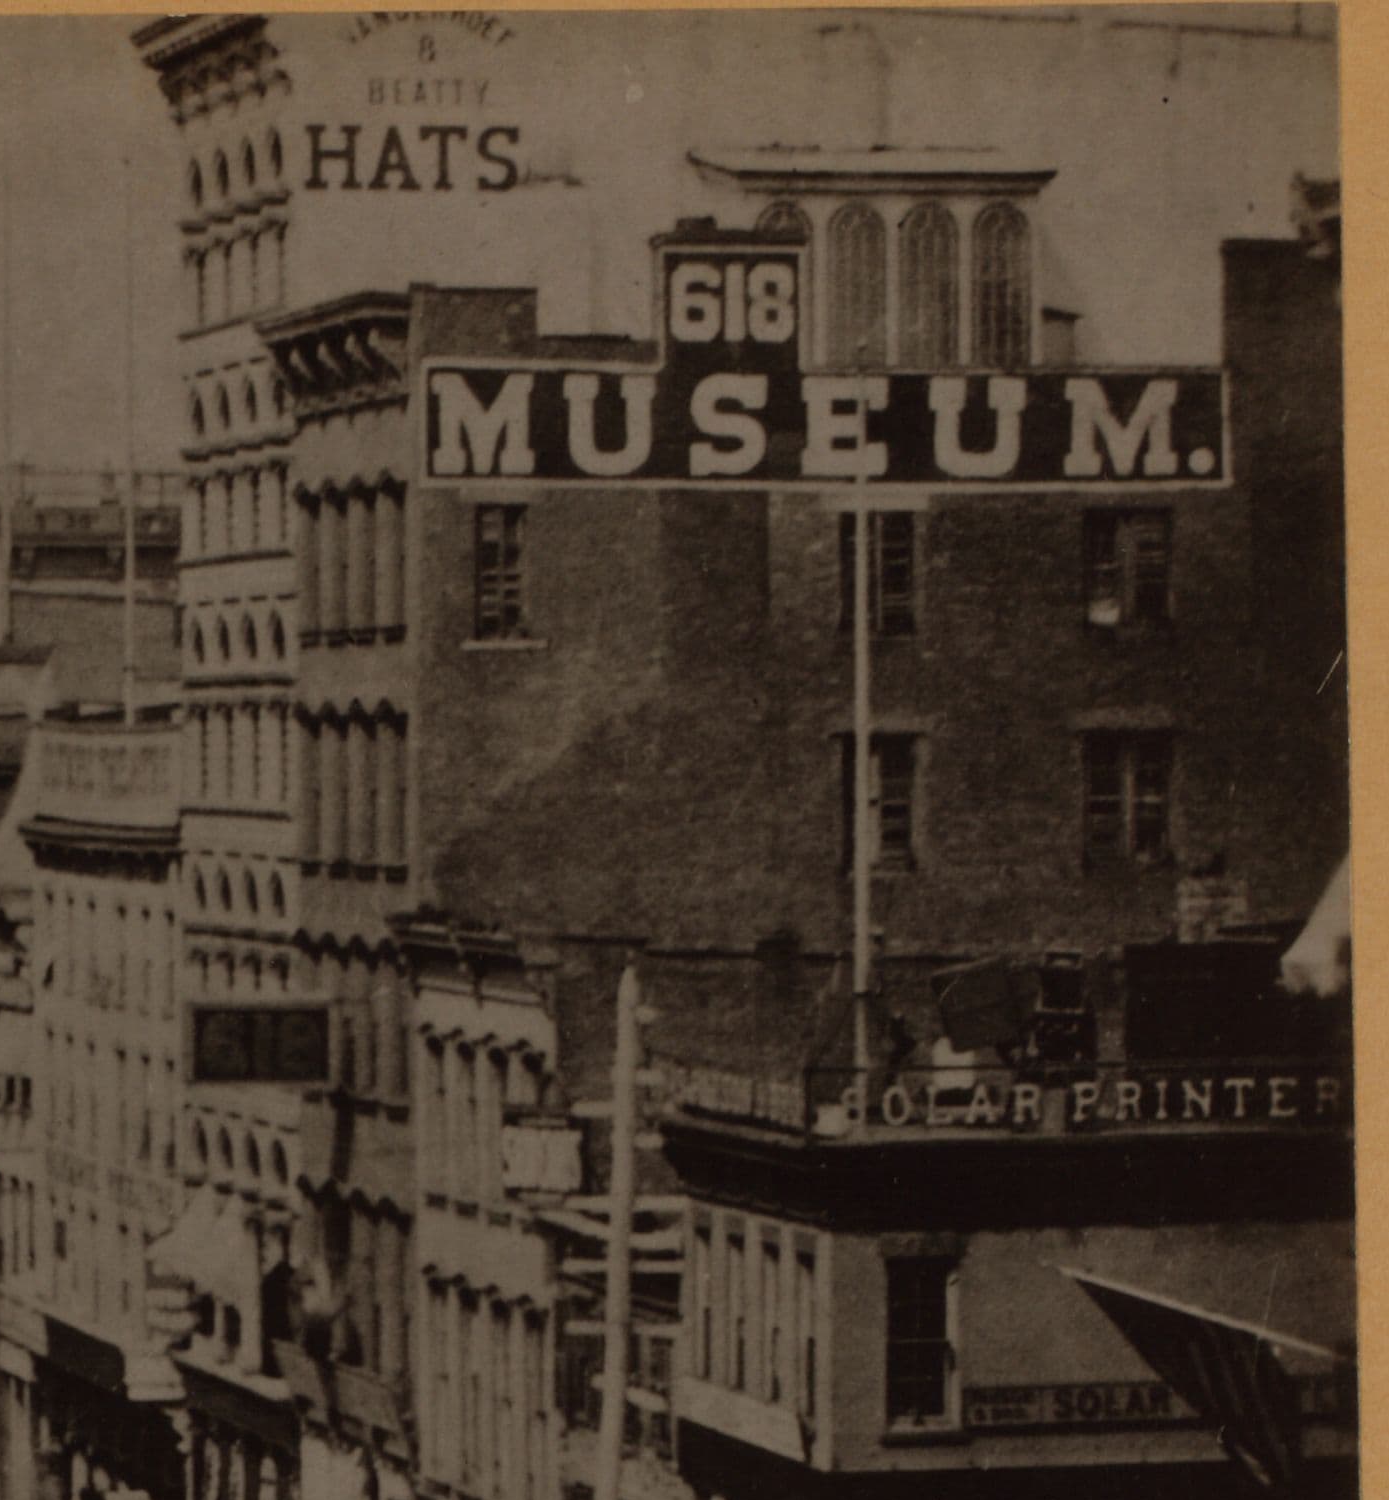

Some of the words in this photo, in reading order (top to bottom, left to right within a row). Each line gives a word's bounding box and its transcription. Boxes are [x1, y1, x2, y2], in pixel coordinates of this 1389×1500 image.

[418, 33, 437, 64] &
[367, 76, 491, 106] BEATTY
[303, 122, 523, 194] HATS
[670, 263, 796, 343] 618
[430, 373, 1217, 478] MUSEUM.
